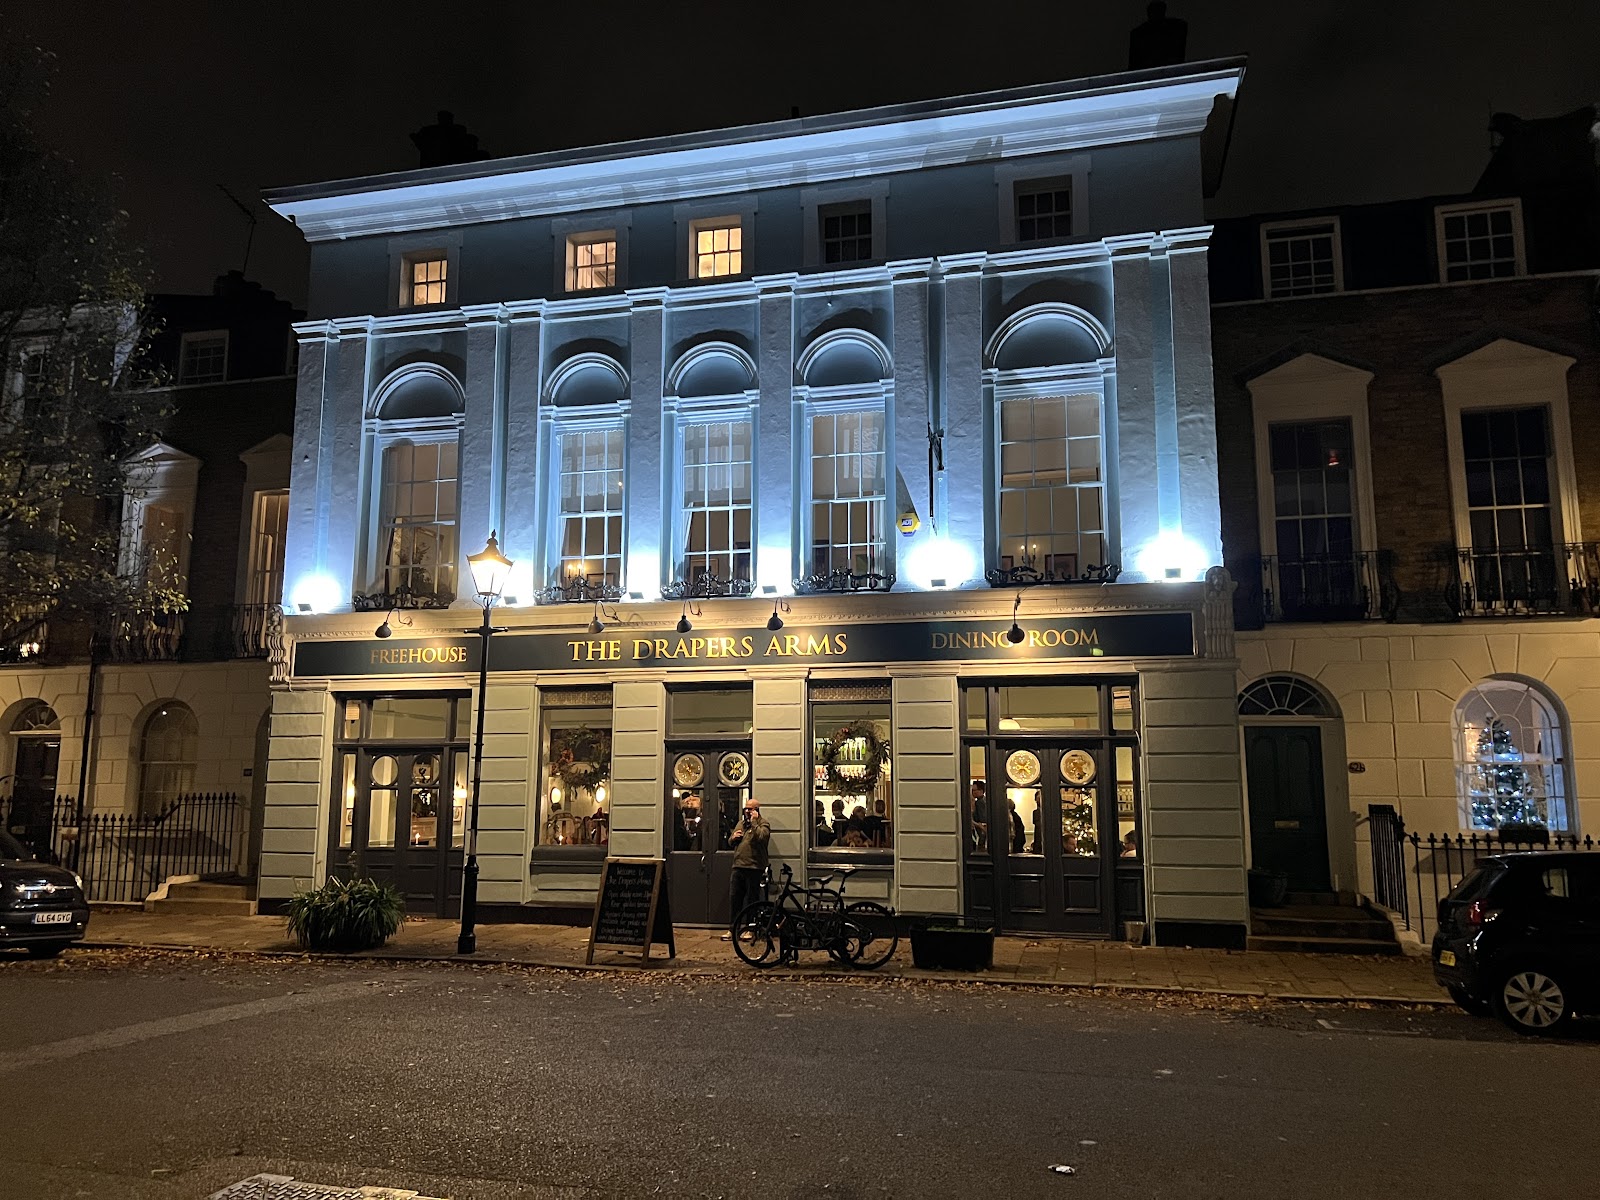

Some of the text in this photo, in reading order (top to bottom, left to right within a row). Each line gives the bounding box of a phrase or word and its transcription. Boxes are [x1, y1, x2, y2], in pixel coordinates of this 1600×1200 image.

[567, 633, 847, 661] THE DRAPERS ARMS
[931, 628, 1099, 649] DINING ROOM
[370, 646, 467, 664] FREEHOUSE
[37, 914, 55, 923] LL64
